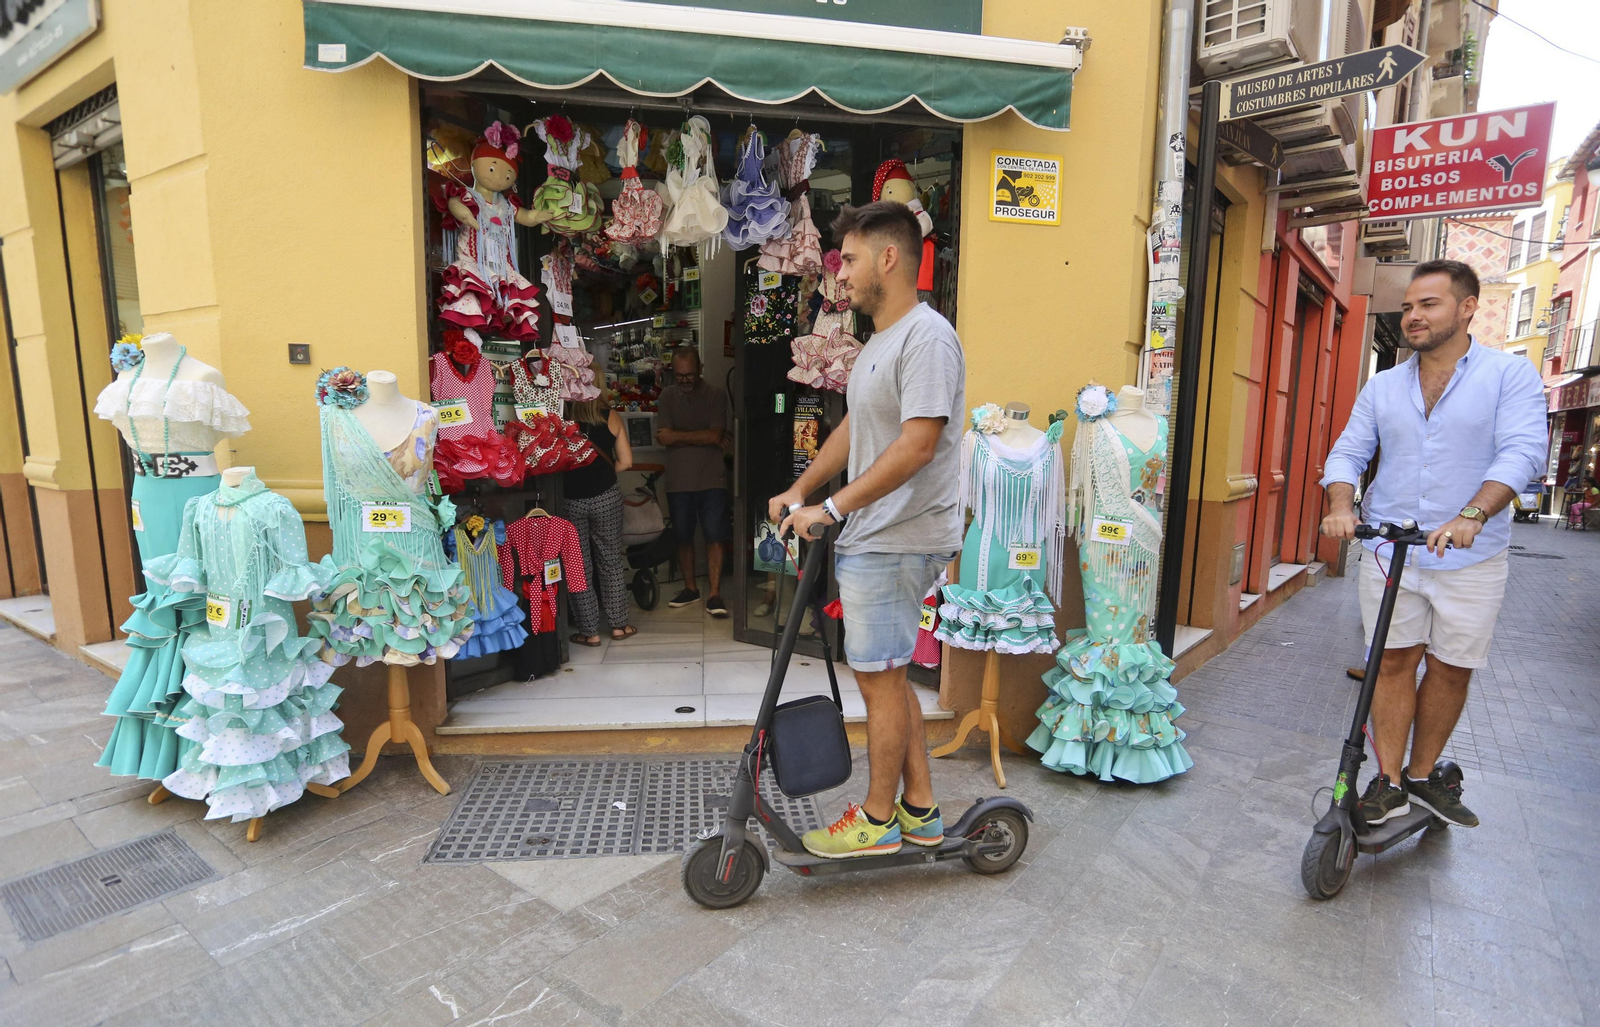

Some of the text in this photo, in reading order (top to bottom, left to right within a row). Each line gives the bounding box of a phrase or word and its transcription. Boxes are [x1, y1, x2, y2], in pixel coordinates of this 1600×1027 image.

[1237, 62, 1345, 97] MUSEO DE ARTES Y
[1236, 73, 1375, 114] COSTUMBRES POPULARES
[1393, 111, 1528, 154] KUN
[996, 157, 1057, 169] CONECTADA
[1374, 148, 1484, 174] BISUTERIA
[1380, 170, 1461, 192] BOLSOS
[1367, 182, 1538, 213] COMPLEMENTOS
[995, 206, 1055, 219] PROSEGUR
[563, 335, 570, 343] 29
[440, 409, 462, 419] 59 €
[524, 412, 534, 420] 59
[372, 513, 387, 521] 29
[1101, 525, 1120, 535] 99€
[1015, 553, 1027, 561] 69
[215, 607, 223, 616] €
